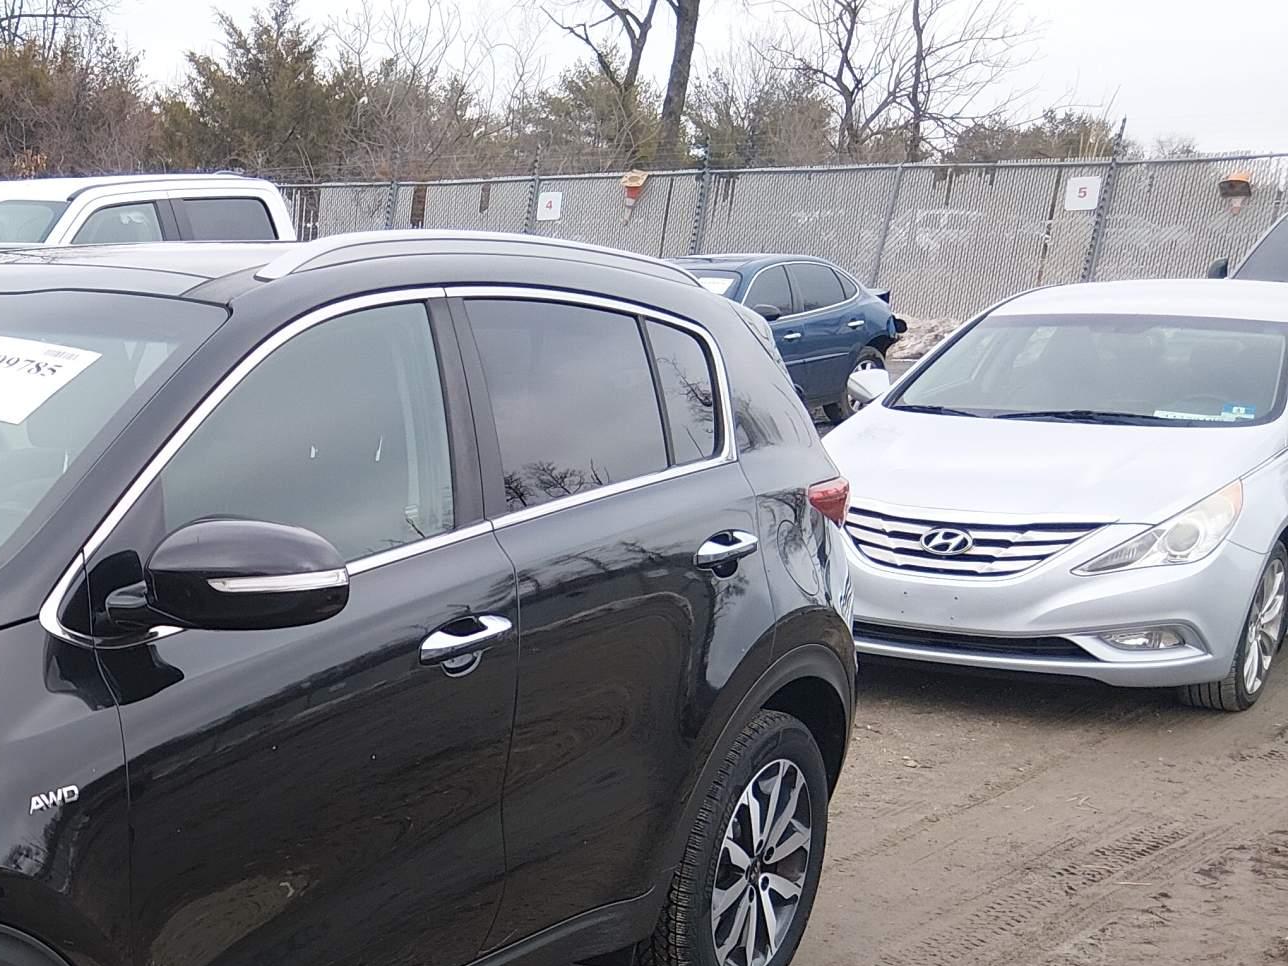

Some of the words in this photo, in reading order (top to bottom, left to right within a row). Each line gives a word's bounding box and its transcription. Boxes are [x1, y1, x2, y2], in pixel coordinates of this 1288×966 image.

[1077, 186, 1088, 199] 5
[545, 200, 553, 210] 4
[29, 784, 79, 815] AWD
